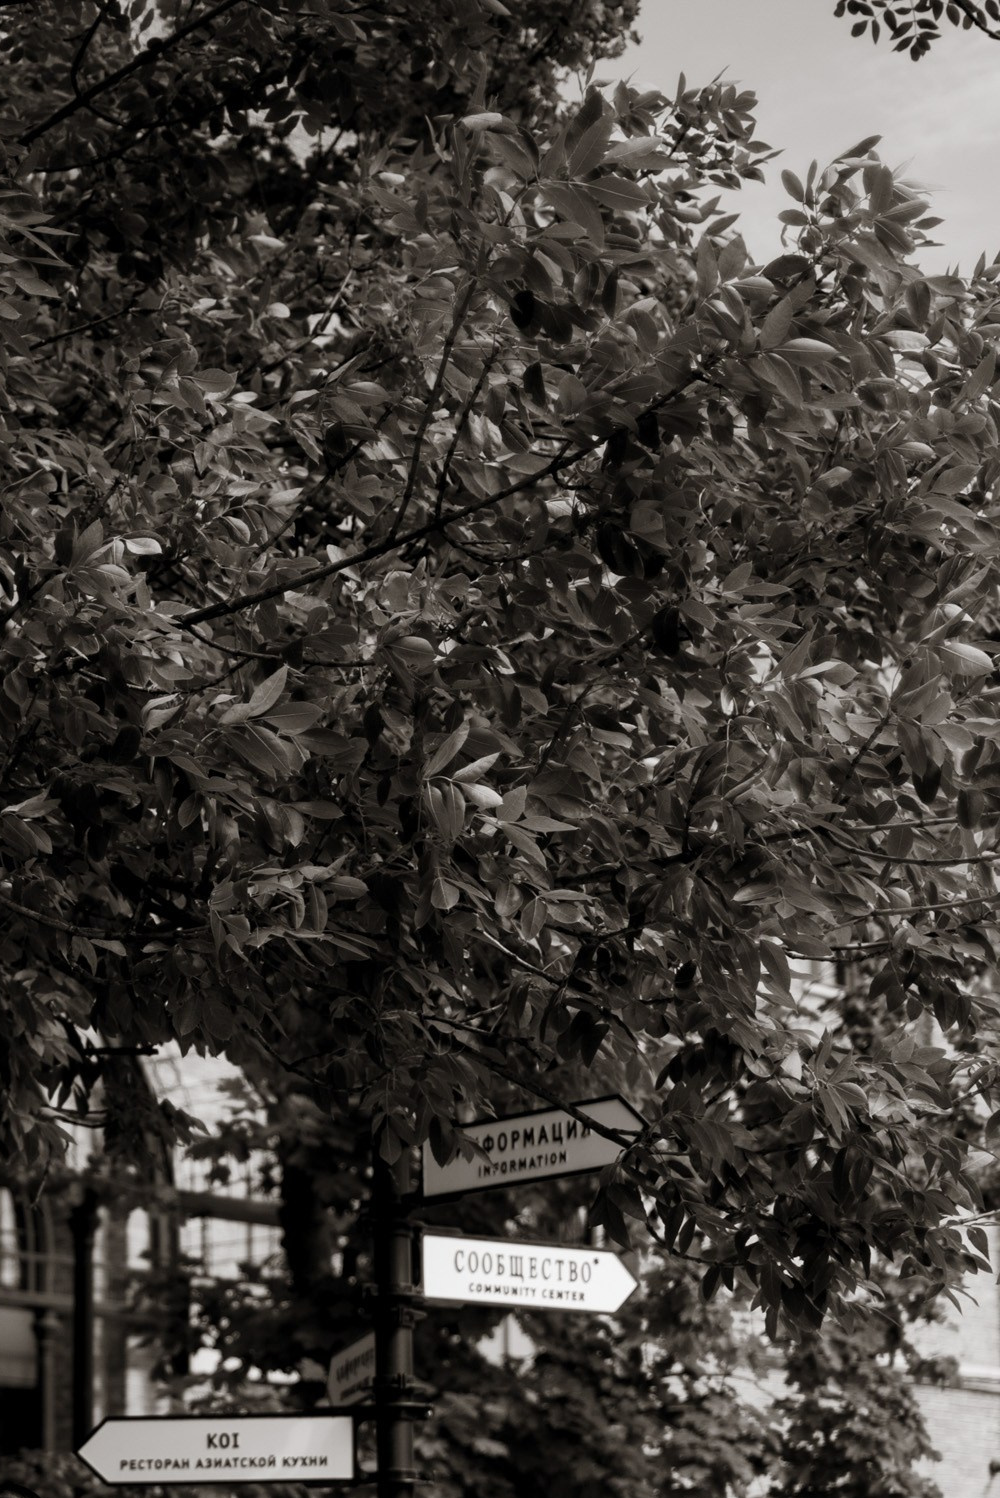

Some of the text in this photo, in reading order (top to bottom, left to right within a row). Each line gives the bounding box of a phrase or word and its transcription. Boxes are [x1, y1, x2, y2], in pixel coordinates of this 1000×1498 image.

[468, 1282, 586, 1302] COMMUNITY CENTER
[207, 1432, 239, 1449] KOI
[120, 1455, 328, 1471] РЕСТОРАН АЗИАТСКОЙ КУХНИ
